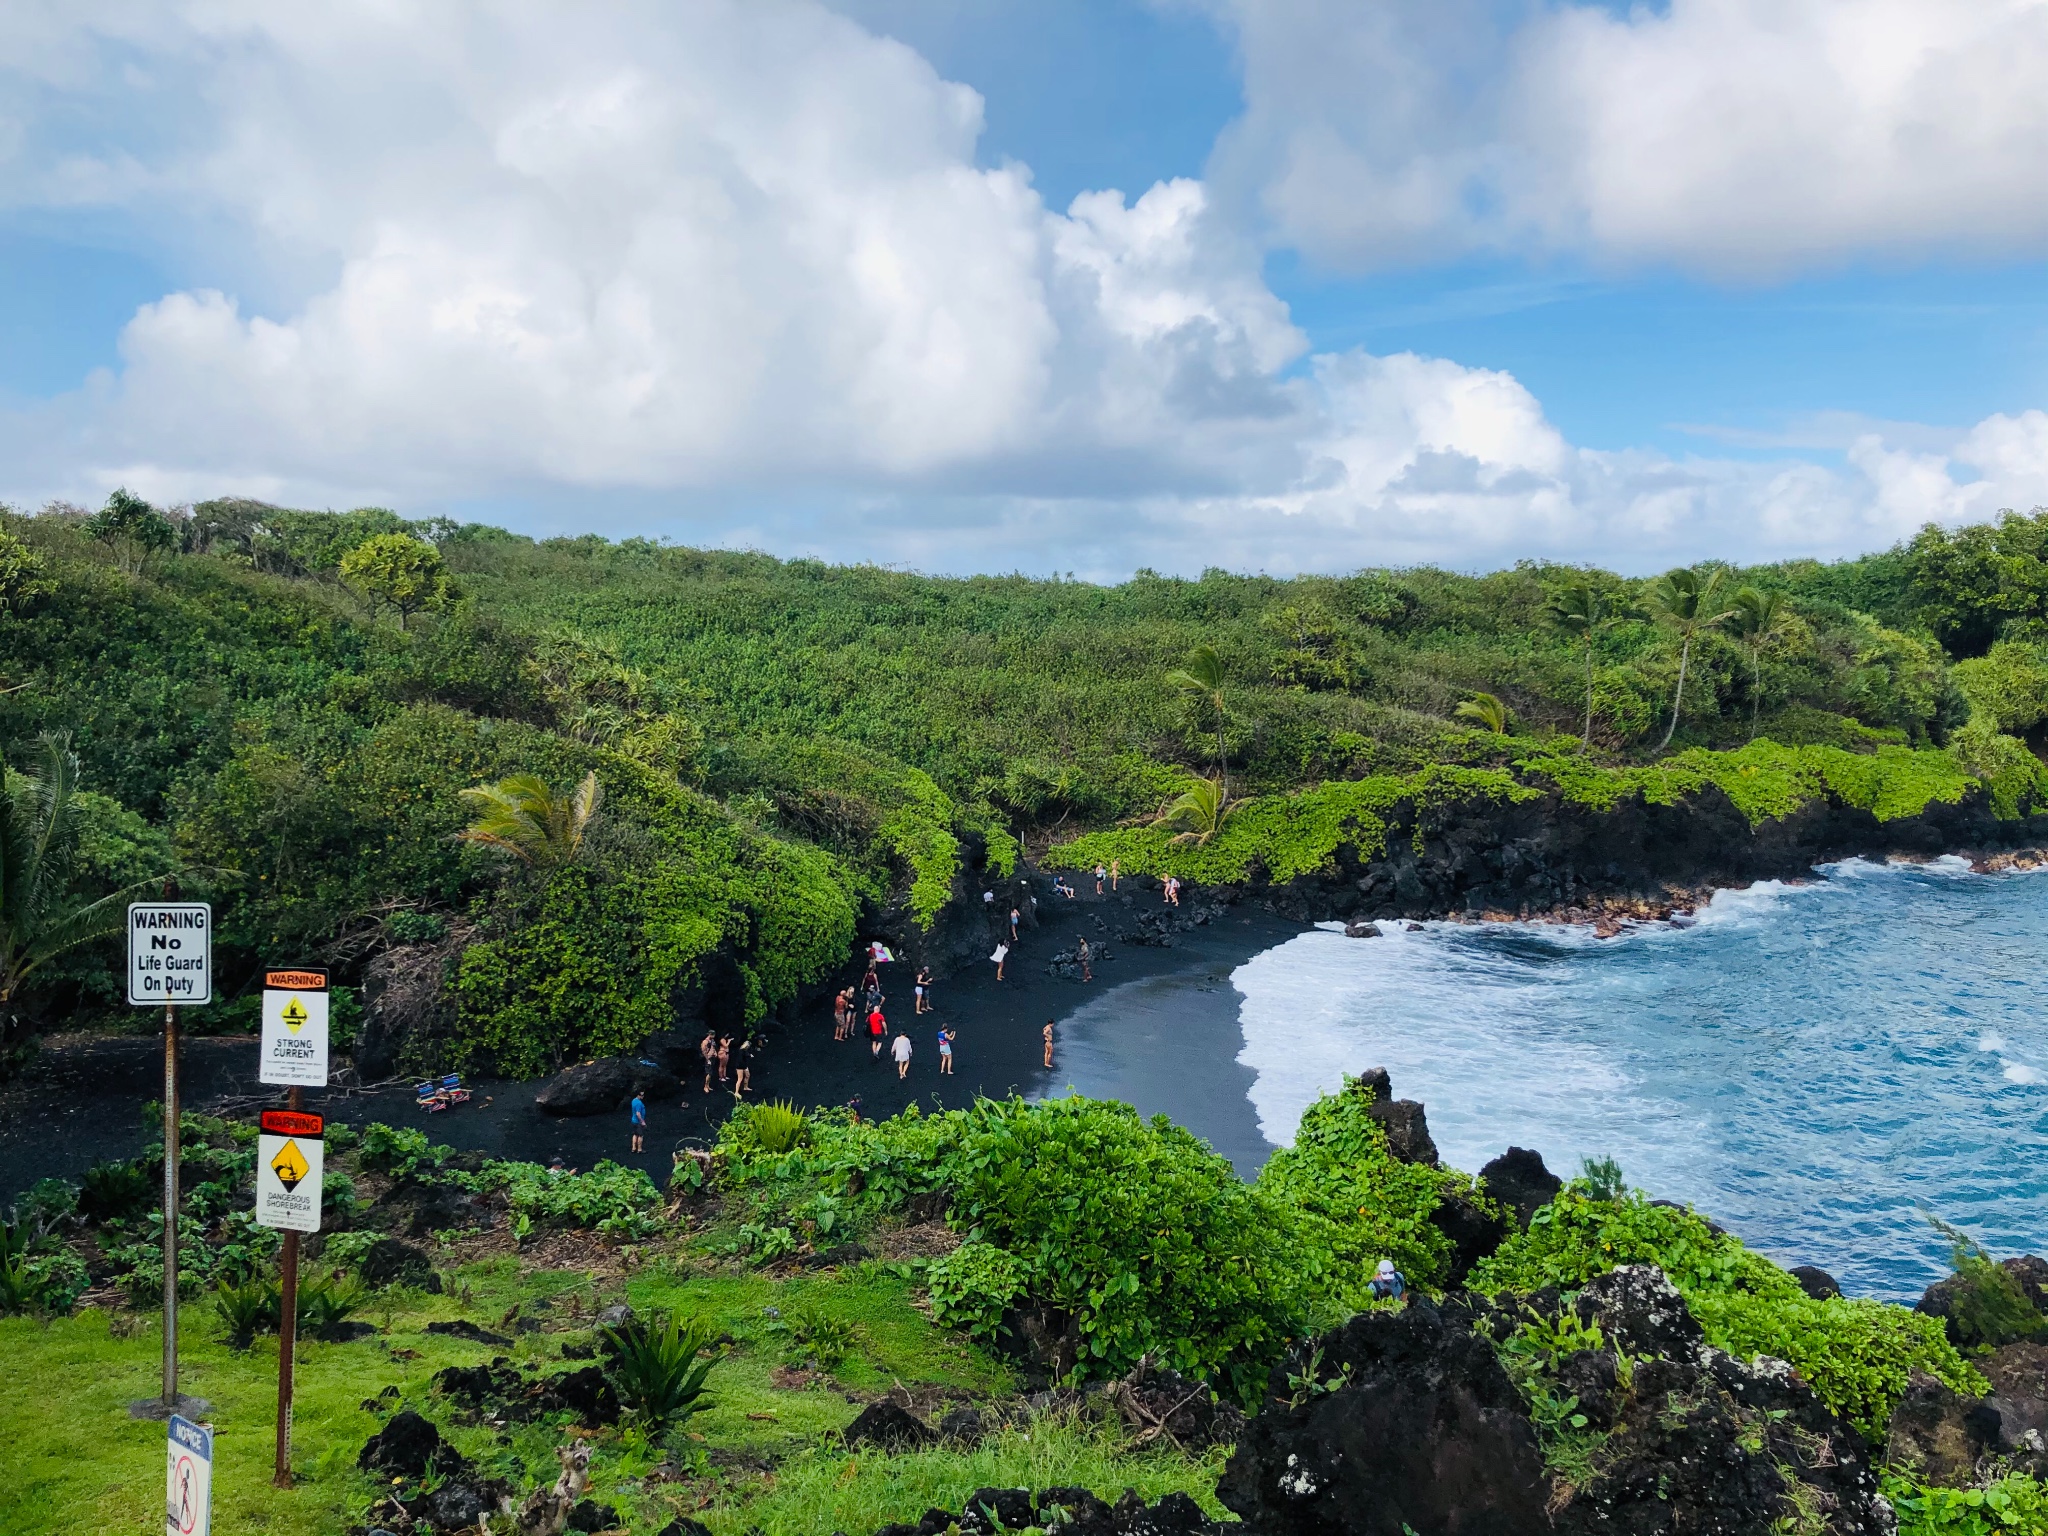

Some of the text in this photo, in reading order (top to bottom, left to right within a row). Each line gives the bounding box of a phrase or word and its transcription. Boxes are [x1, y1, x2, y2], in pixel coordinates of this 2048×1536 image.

[134, 912, 204, 929] WARNING
[151, 935, 182, 950] No
[138, 955, 203, 970] Life Guard
[144, 975, 194, 995] On Duty
[269, 974, 323, 986] WARNING
[276, 1038, 313, 1049] STRONG
[273, 1047, 316, 1059] CURRENT
[267, 1115, 319, 1131] WARNING
[267, 1191, 311, 1204] DANGEROUS
[266, 1200, 311, 1212] SHOREBREAK
[176, 1422, 201, 1450] NOTICE
